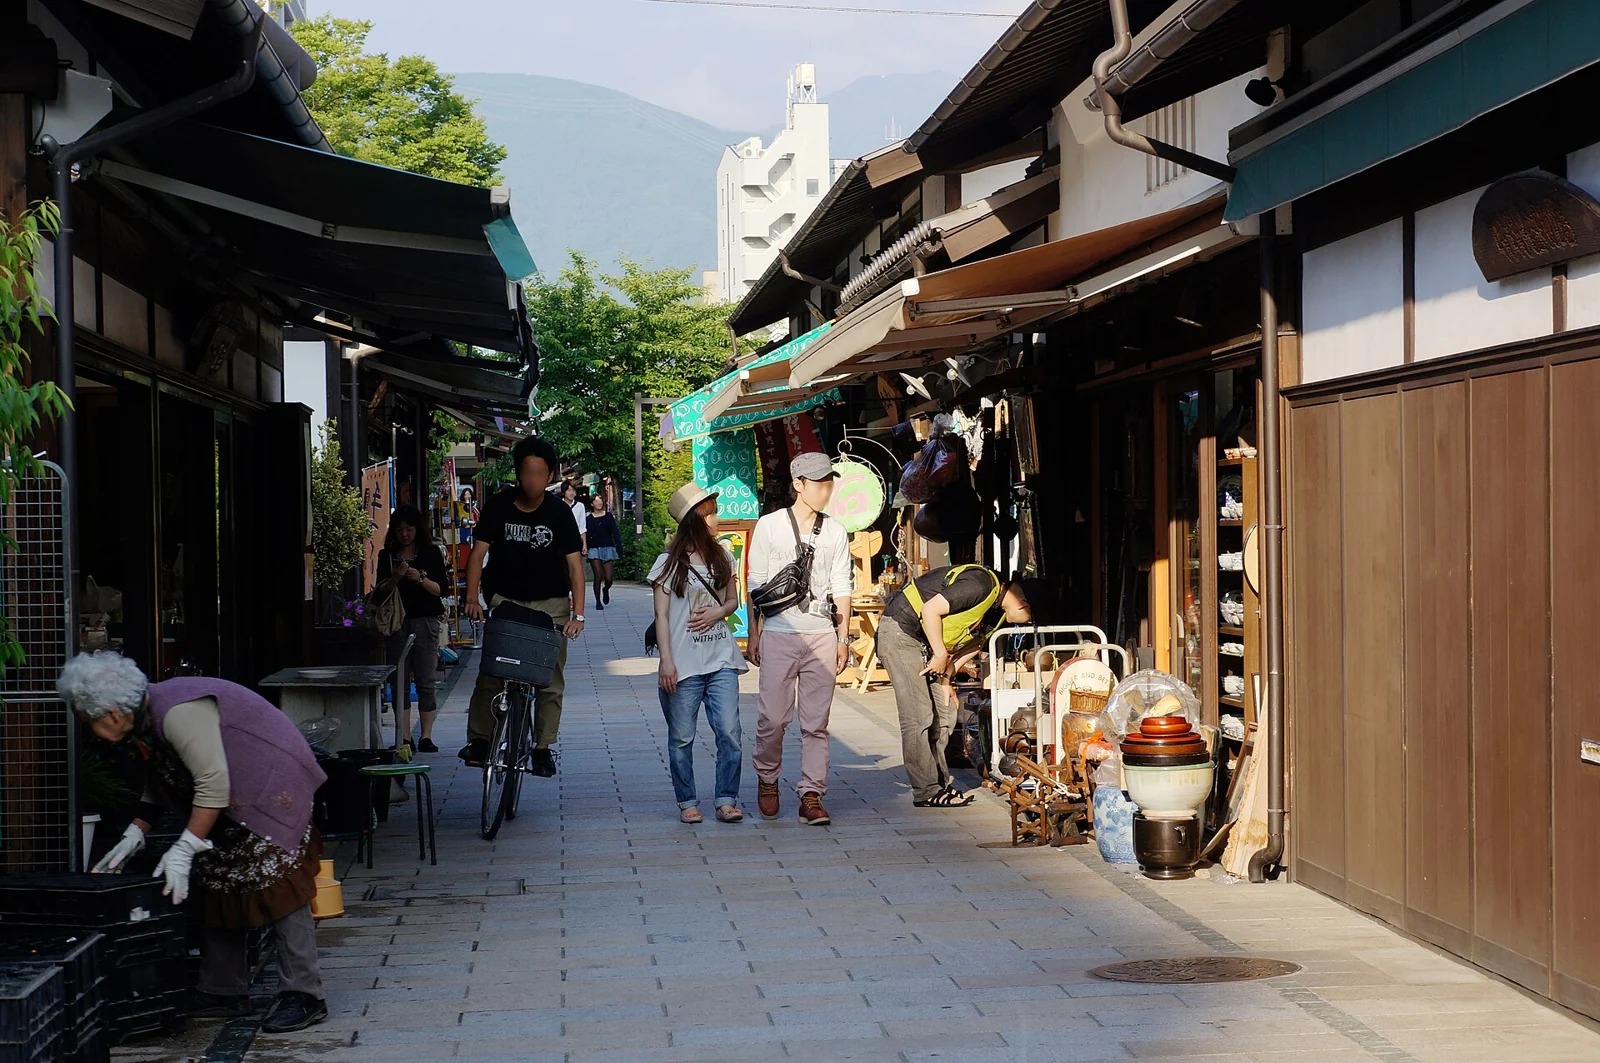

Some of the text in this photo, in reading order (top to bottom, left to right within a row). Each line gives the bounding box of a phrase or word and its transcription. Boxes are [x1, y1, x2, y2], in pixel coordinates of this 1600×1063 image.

[692, 631, 727, 643] WITH YOU
[1058, 674, 1078, 695] BIGGER
[1081, 671, 1095, 679] AND
